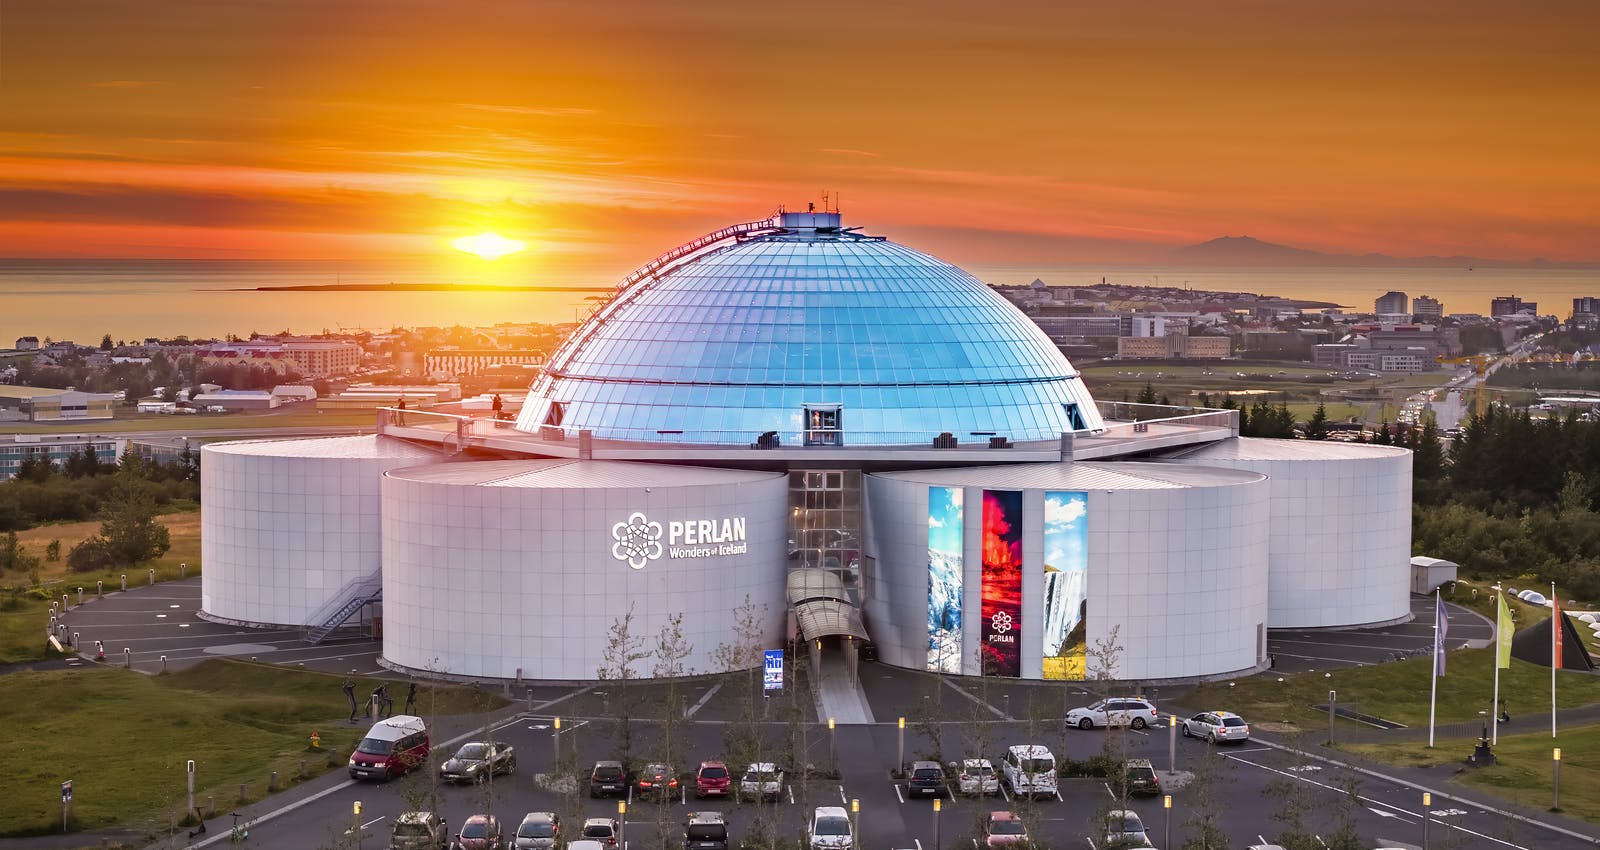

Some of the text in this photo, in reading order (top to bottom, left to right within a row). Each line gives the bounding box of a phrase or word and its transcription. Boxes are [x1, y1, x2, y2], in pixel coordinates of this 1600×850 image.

[669, 517, 746, 545] PERLAN
[669, 542, 747, 559] Wonders of Iceland
[989, 635, 1014, 643] PERLAN
